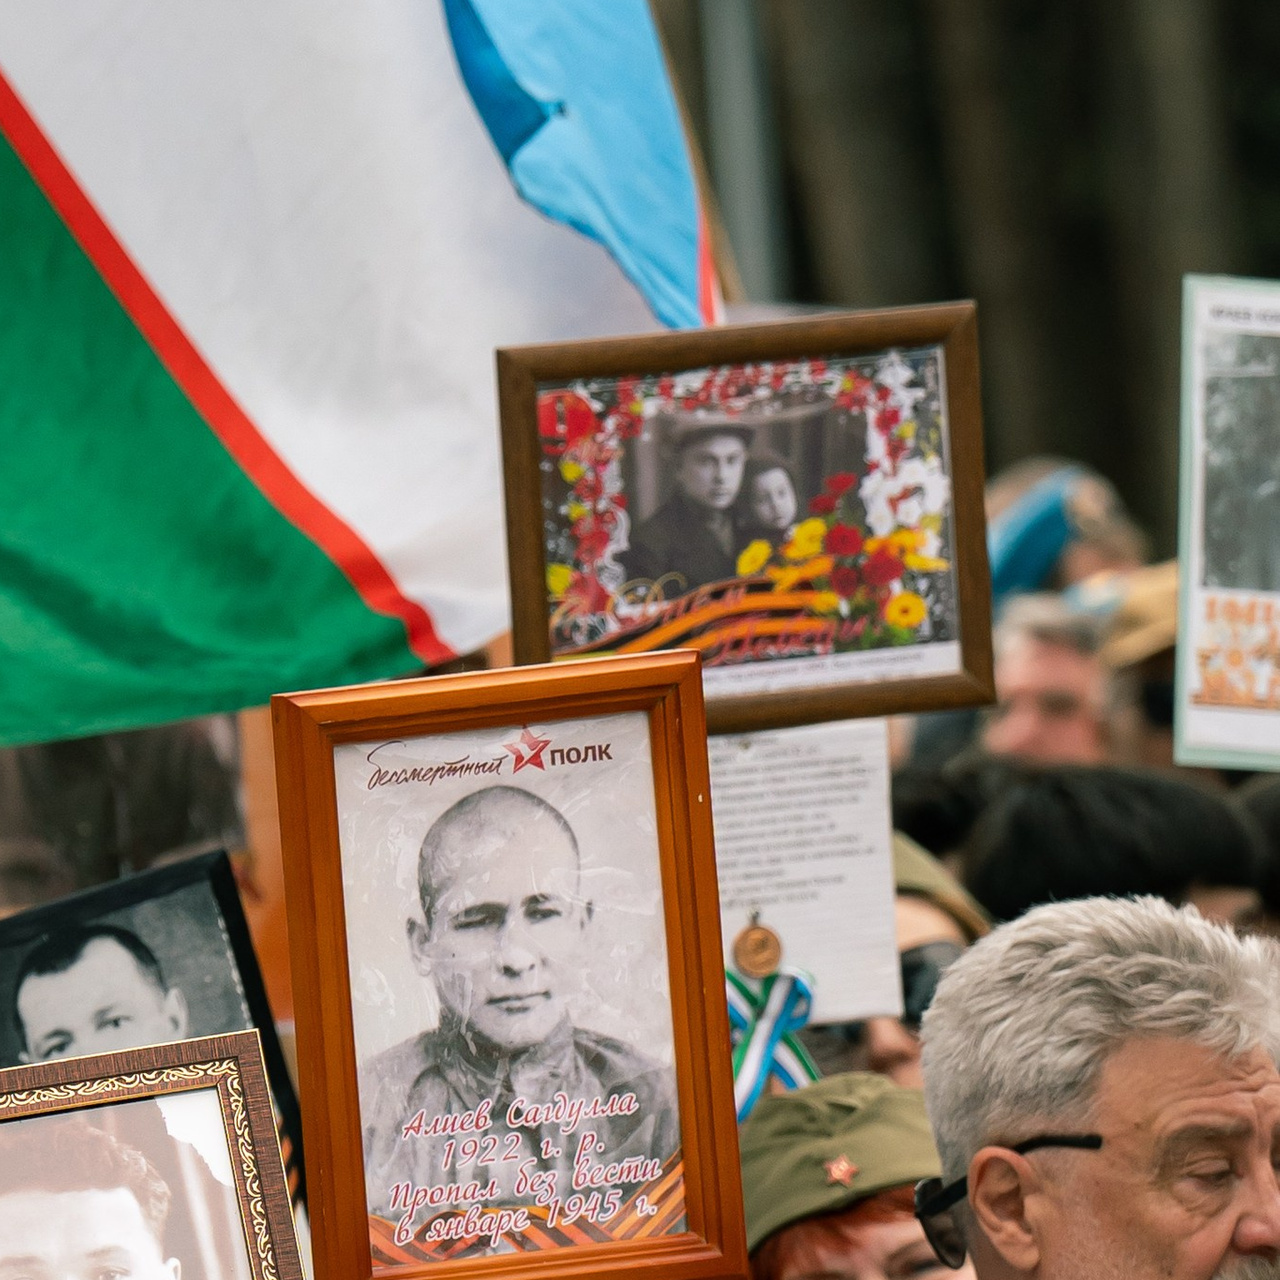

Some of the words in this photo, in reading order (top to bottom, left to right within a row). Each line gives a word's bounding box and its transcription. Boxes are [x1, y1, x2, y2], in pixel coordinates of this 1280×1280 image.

[402, 1098, 492, 1140] Алиев
[506, 1091, 639, 1134] Сагдулла
[442, 1132, 521, 1171] 1922
[541, 1139, 561, 1158] г.
[575, 1130, 605, 1165] р.
[390, 1179, 500, 1218] Пропал
[515, 1157, 558, 1204] без
[572, 1153, 662, 1190] вести
[393, 1218, 414, 1247] в
[426, 1203, 530, 1247] январе
[547, 1188, 622, 1228] 1945
[635, 1195, 658, 1218] г.
